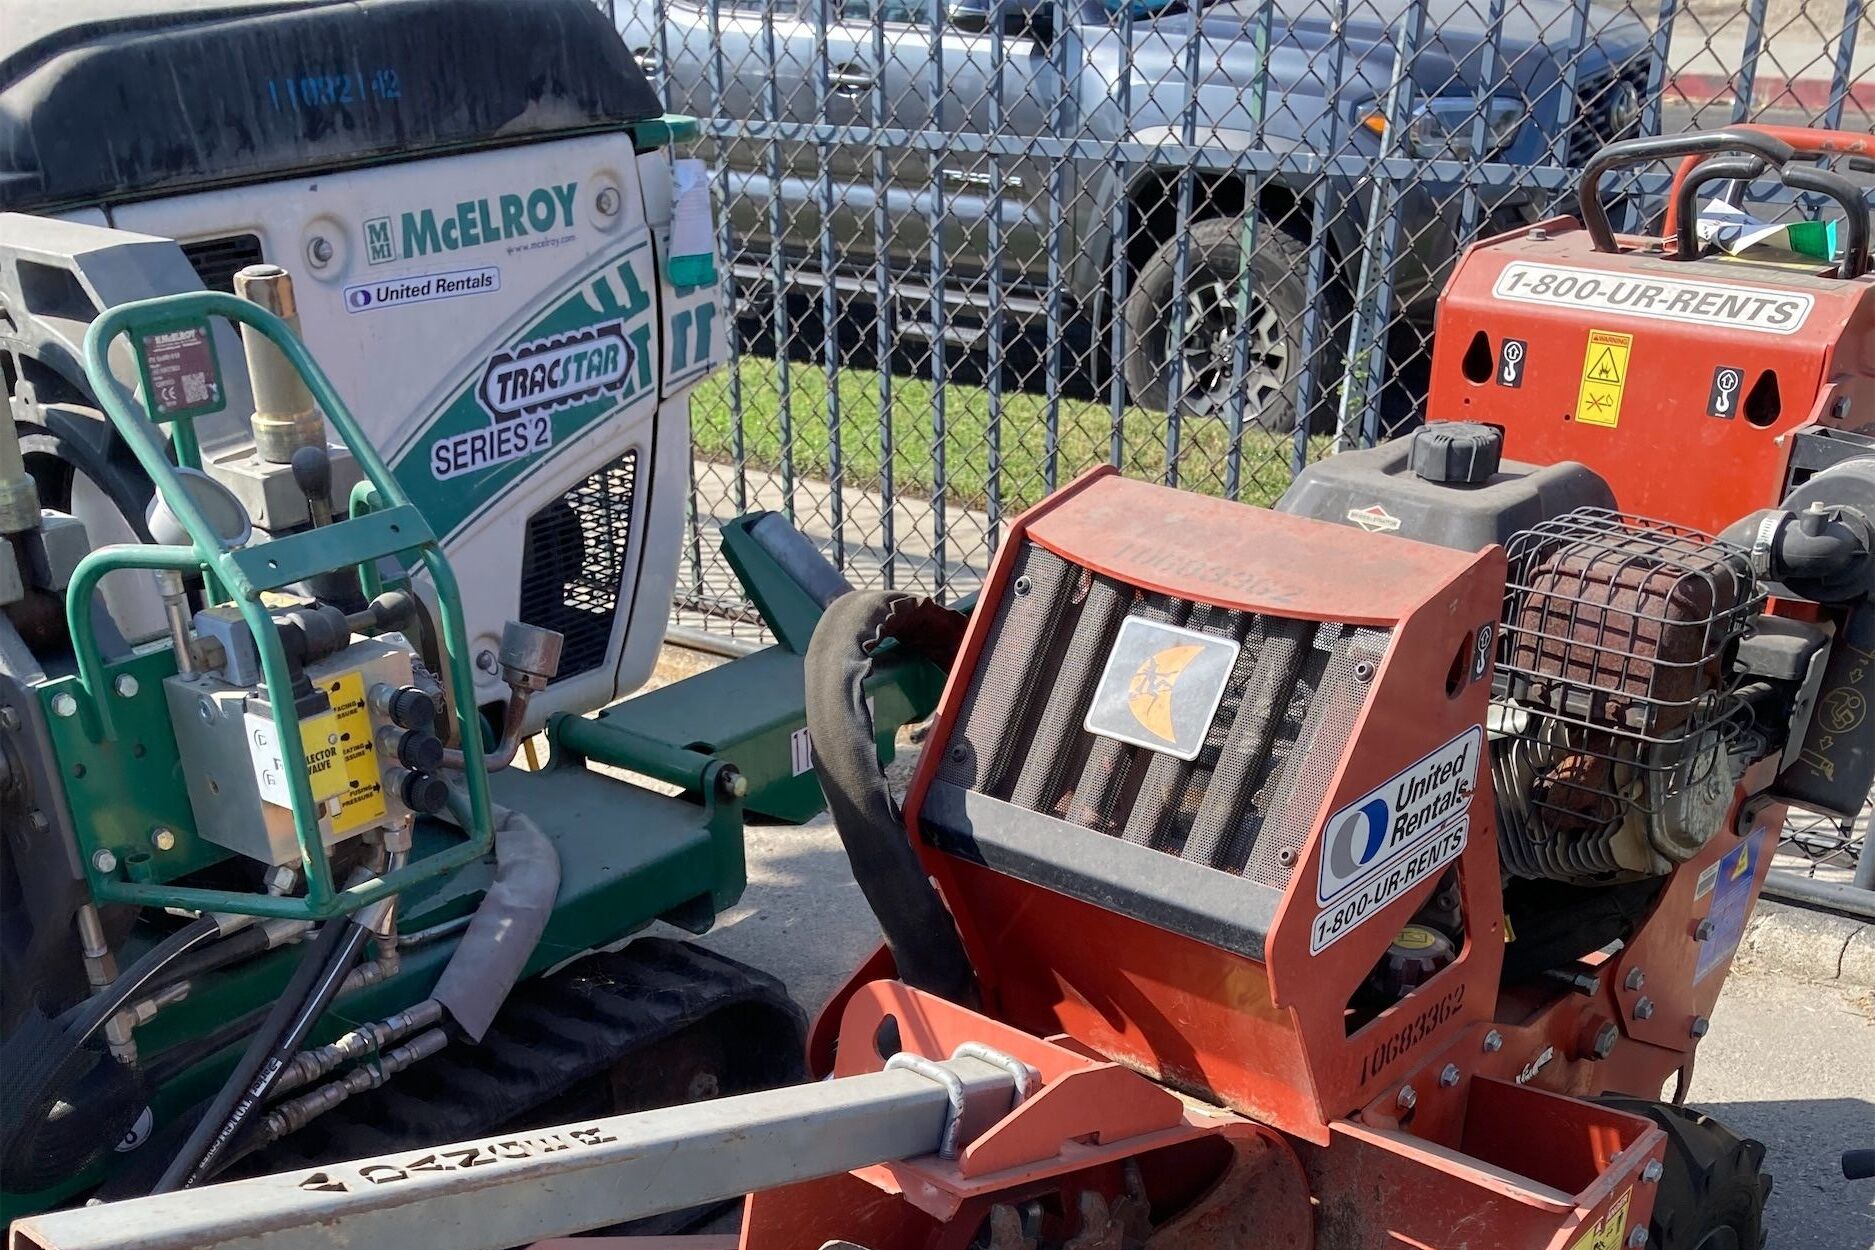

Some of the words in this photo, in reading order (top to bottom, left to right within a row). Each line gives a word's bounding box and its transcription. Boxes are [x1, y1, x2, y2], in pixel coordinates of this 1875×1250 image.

[401, 182, 578, 259] McELROY
[376, 280, 430, 303] United
[436, 272, 493, 294] Rentals
[1506, 271, 1799, 324] 1-800-UR-RENTS
[497, 343, 619, 404] TRACSTAR
[435, 422, 528, 475] SERIES
[534, 417, 548, 447] 2
[306, 746, 337, 765] LECTOR
[1395, 743, 1470, 813] United
[342, 792, 374, 807] PRESSURE
[1390, 778, 1470, 847] Rentals
[1318, 826, 1464, 943] 1-800-UR-RENTS
[1360, 983, 1466, 1086] 10683362
[358, 1127, 618, 1184] DANGER
